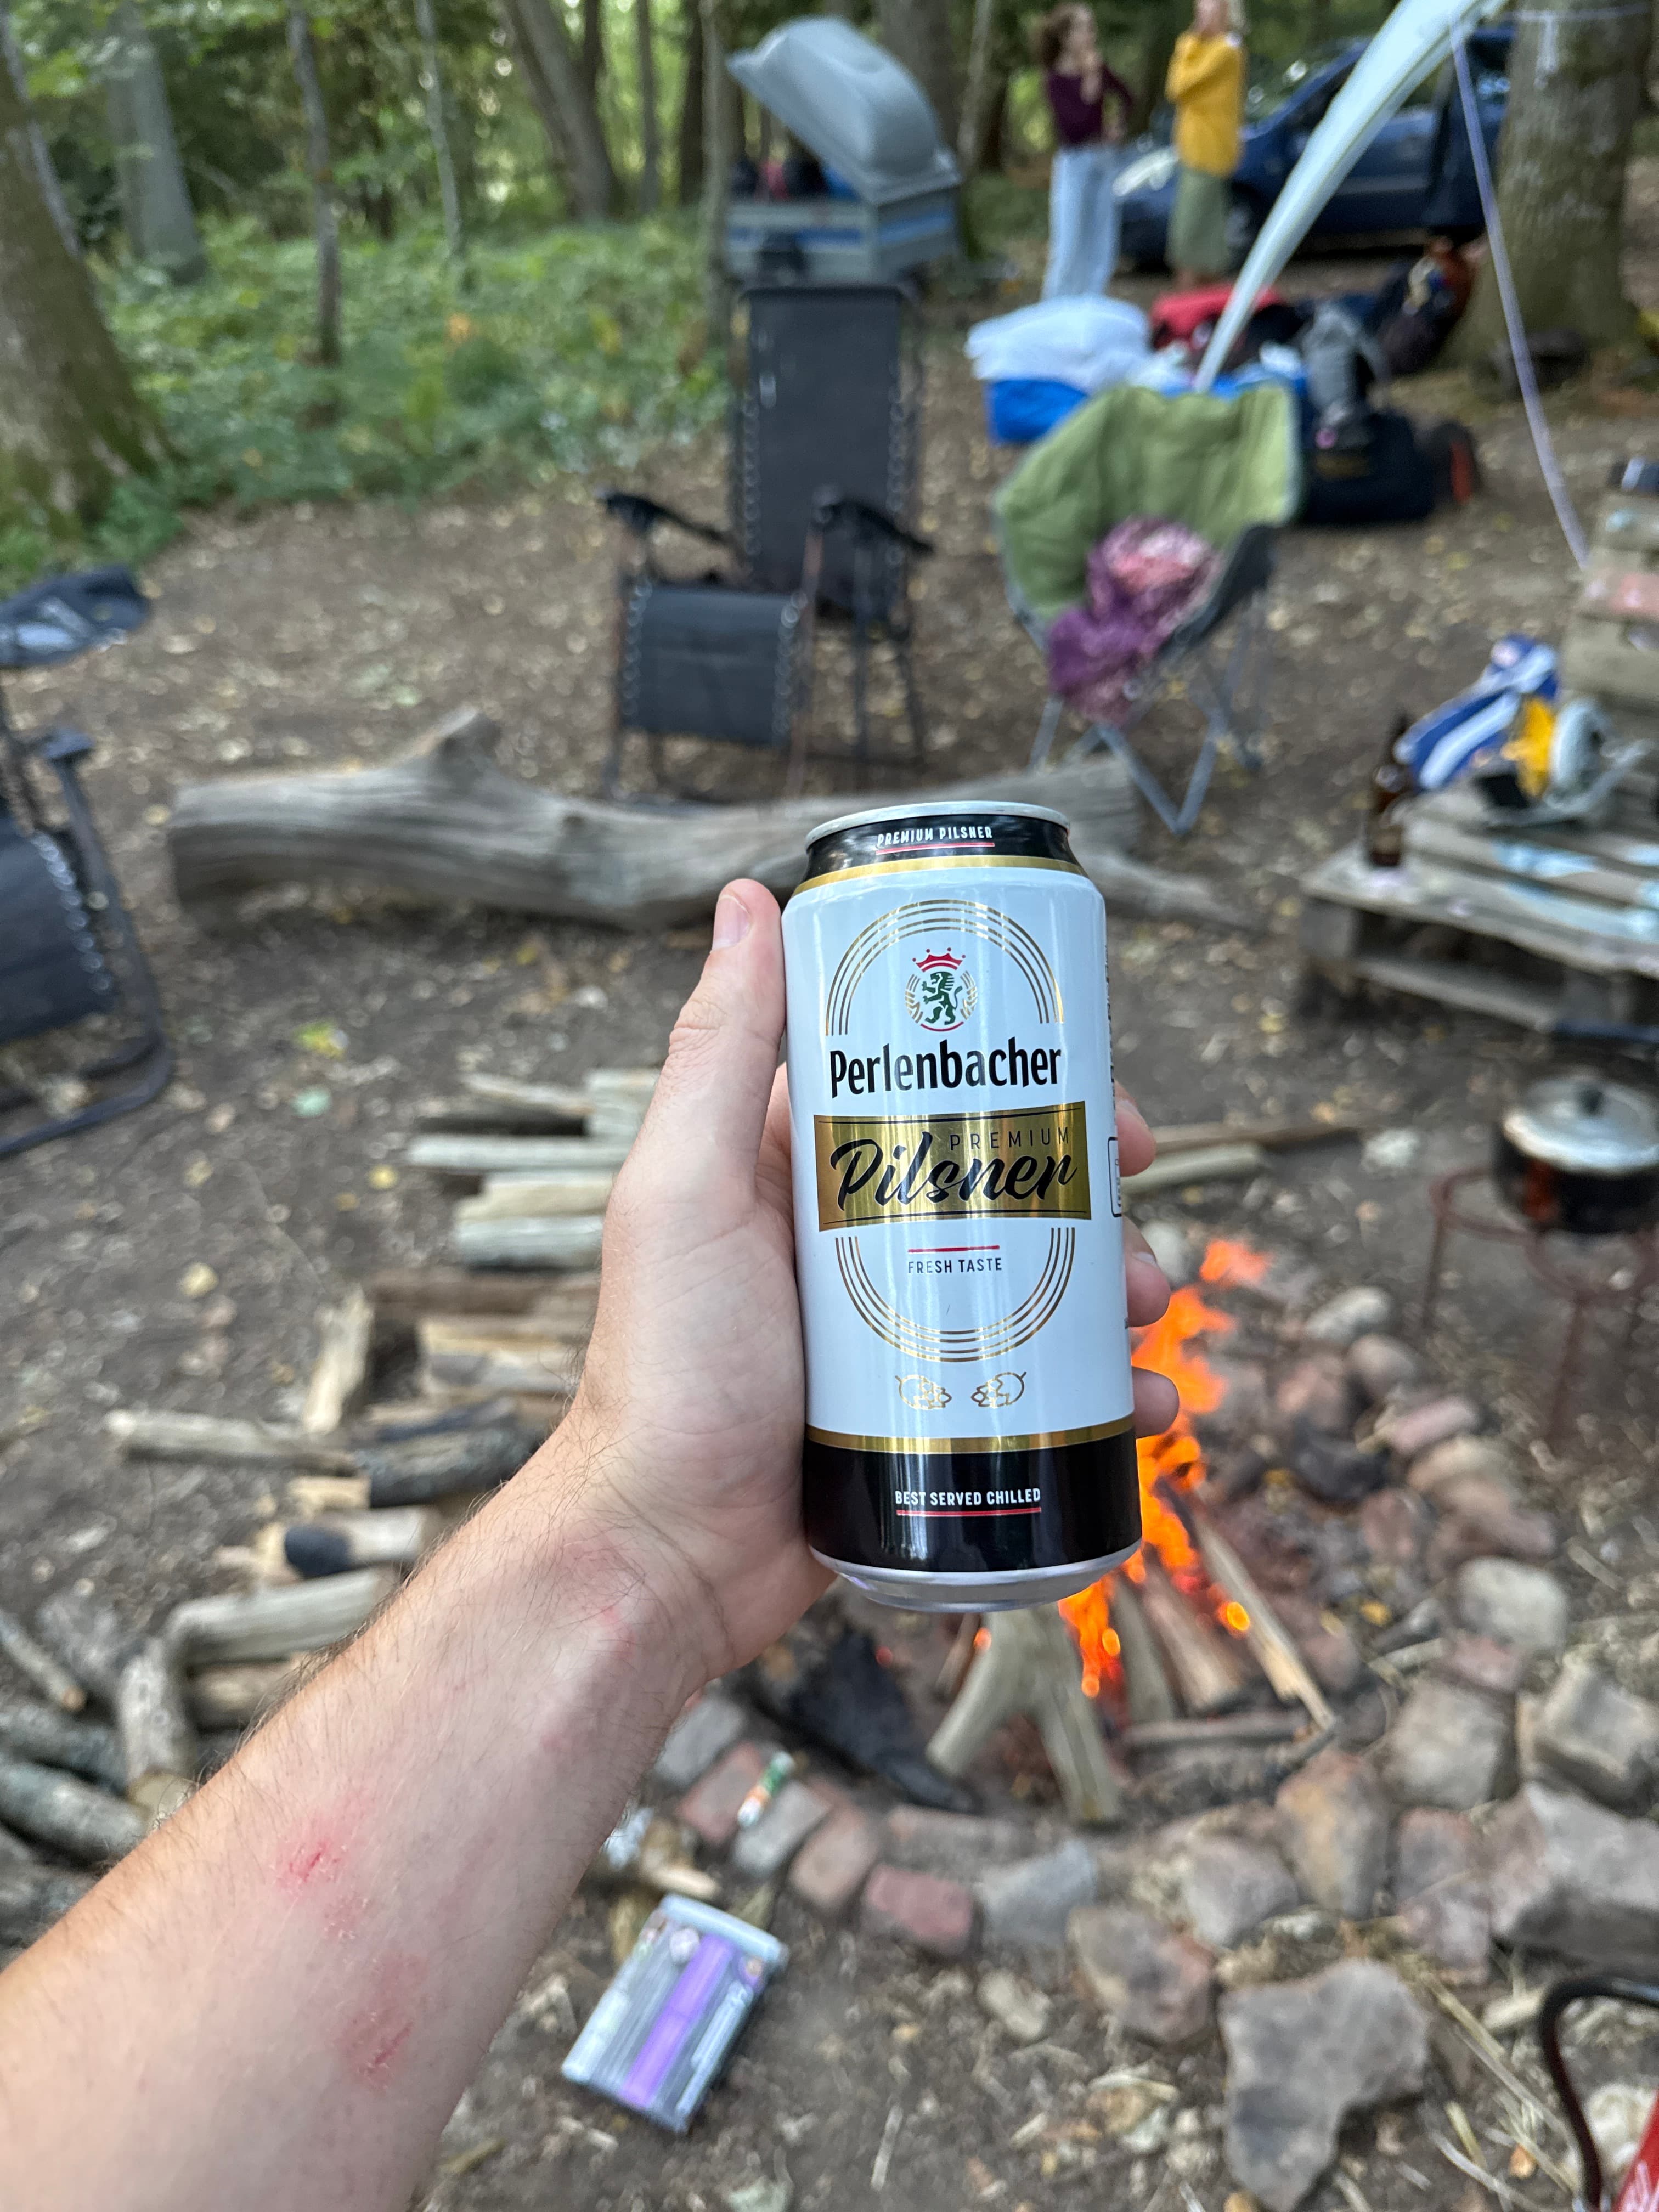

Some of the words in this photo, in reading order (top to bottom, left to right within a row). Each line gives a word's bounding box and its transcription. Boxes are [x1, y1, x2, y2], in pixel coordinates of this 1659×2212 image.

[877, 828, 934, 846] PREMIUM
[939, 826, 992, 840] PILSNER
[830, 1036, 1062, 1098] Perlenbacher
[950, 1127, 1069, 1151] PREMIUM
[830, 1132, 1077, 1211] Pilsner
[908, 1260, 952, 1274] FRESH
[958, 1257, 1002, 1273] TASTE
[895, 1490, 926, 1506] BEST
[930, 1491, 982, 1505] SERVED
[986, 1488, 1041, 1504] CHILLED
